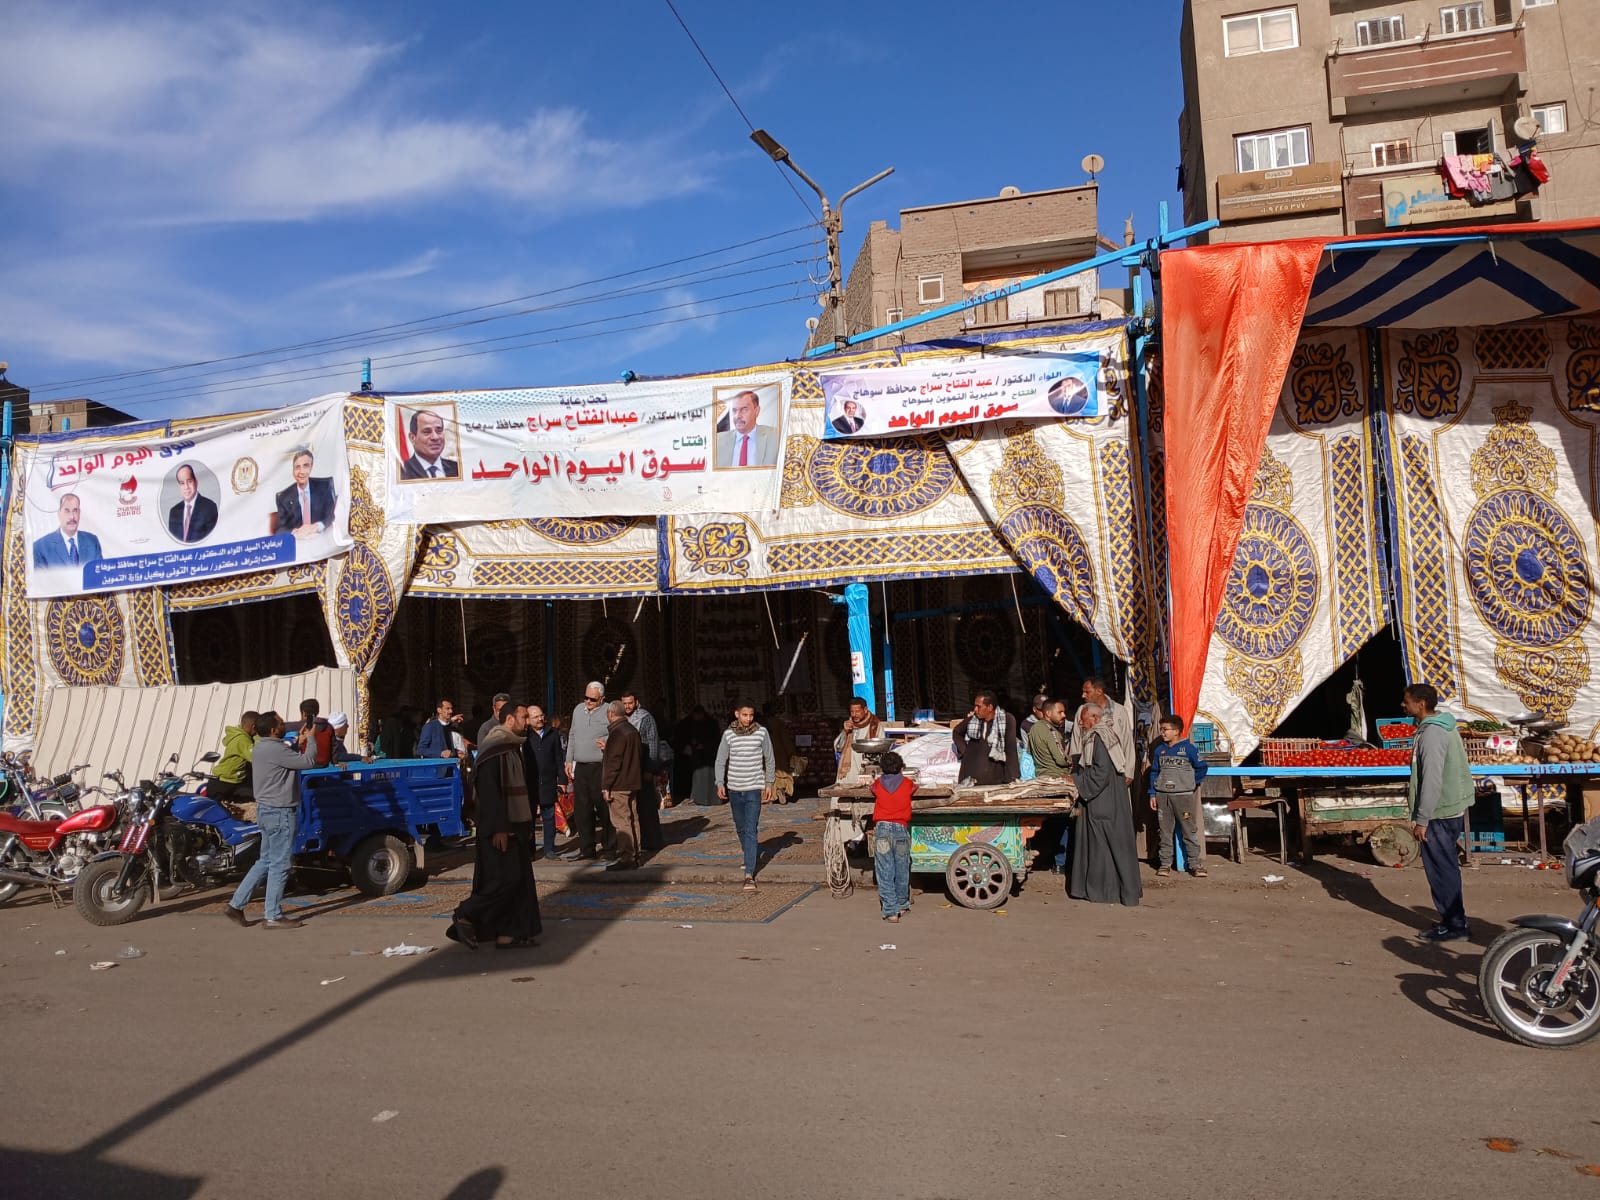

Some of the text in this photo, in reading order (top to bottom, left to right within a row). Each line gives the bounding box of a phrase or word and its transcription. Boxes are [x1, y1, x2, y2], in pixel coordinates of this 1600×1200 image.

[1002, 374, 1036, 387] الدكتور
[1039, 371, 1062, 381] اللواء
[886, 384, 917, 394] محافظ
[920, 382, 942, 394] سراج
[945, 379, 973, 392] الفتاح
[976, 379, 992, 389] عبد
[853, 388, 883, 399] سوهاج
[936, 393, 967, 404] التموين
[970, 391, 998, 400] مديرية
[560, 394, 608, 408] تحت رعاية
[902, 398, 933, 407] بسوهاج
[290, 413, 312, 423] التموين
[683, 408, 707, 421] اللواء
[888, 403, 1018, 428] سوق اليوم الواحد
[262, 418, 288, 428] والتجارة
[465, 421, 494, 432] سوهاج
[496, 418, 524, 430] محافظ
[527, 413, 562, 432] سراج
[249, 431, 269, 440] سوهاج
[272, 426, 290, 436] تموين
[672, 435, 707, 450] إفتتاح
[59, 440, 195, 476] سوق اليوم الواحد
[472, 449, 706, 484] سوق اليوم الواحد
[244, 542, 261, 553] السيد
[262, 539, 283, 550] برعاية
[227, 546, 243, 555] اللواء
[139, 558, 157, 568] سراج
[241, 556, 261, 566] إشراف
[261, 553, 277, 562] تحت
[95, 564, 116, 573] سوهاج
[117, 560, 138, 569] محافظ
[190, 564, 209, 575] سامح
[102, 574, 127, 585] التموين
[144, 571, 165, 580] وكيل
